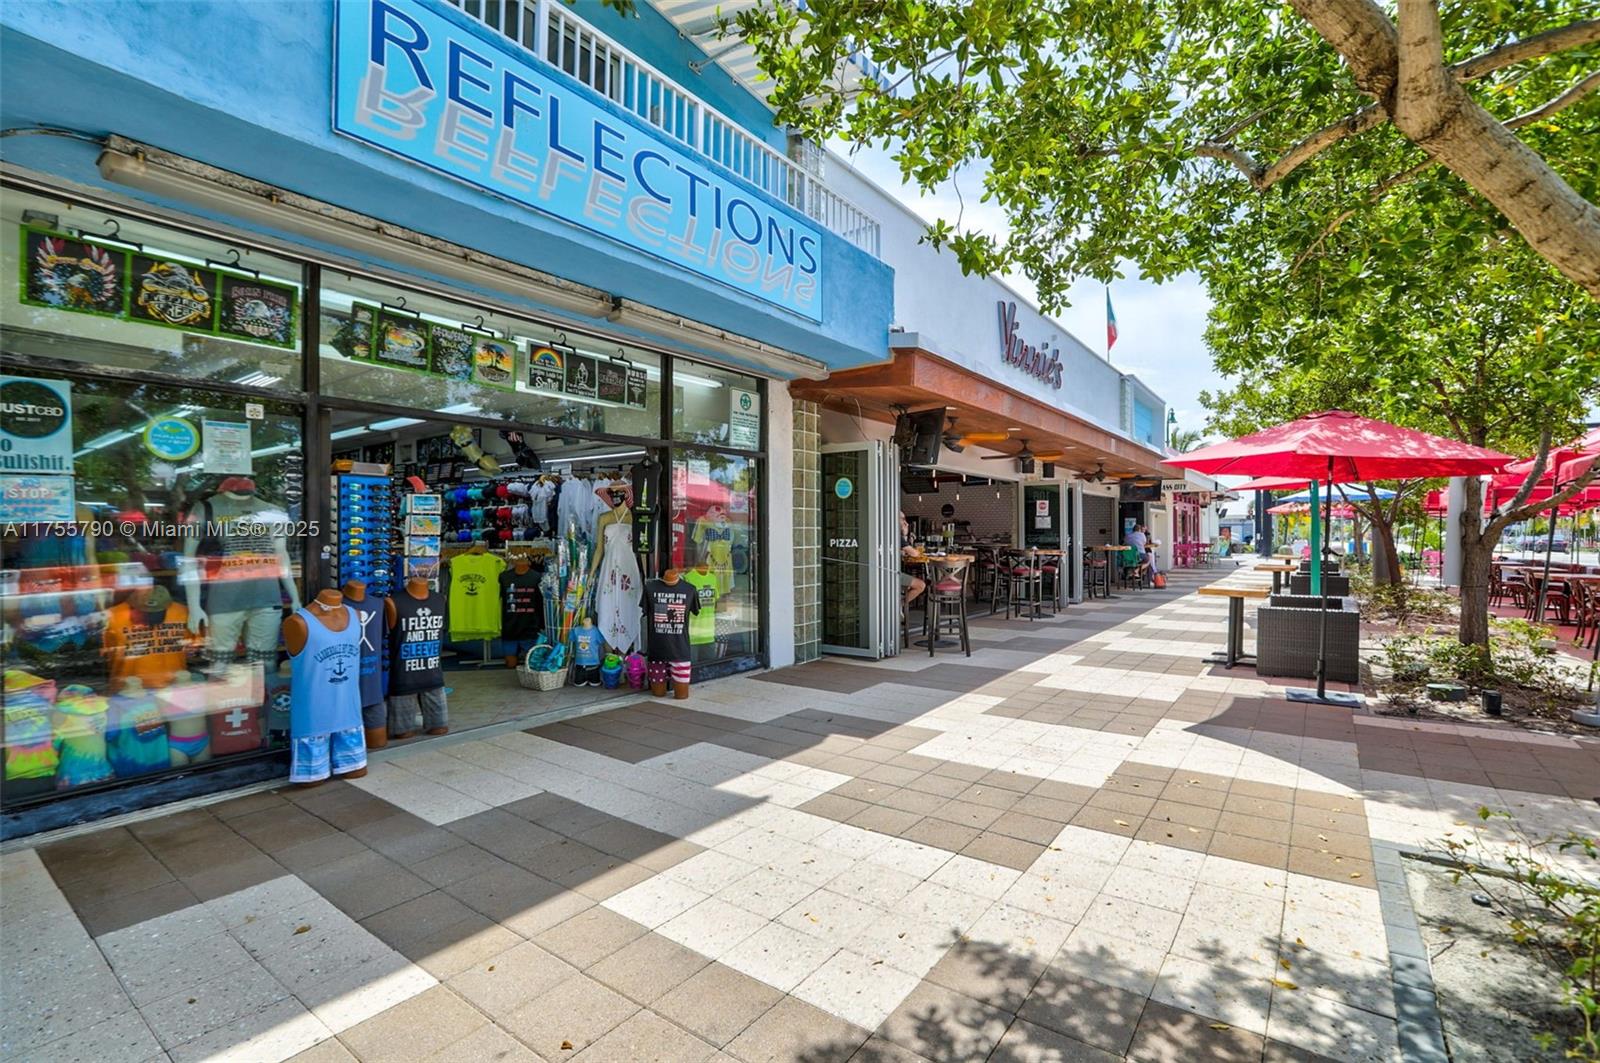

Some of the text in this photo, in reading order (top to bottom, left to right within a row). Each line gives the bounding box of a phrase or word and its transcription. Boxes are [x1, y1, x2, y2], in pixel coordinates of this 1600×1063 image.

[370, 0, 817, 275] REFLECTIONS
[997, 301, 1063, 390] Vinnie's
[0, 438, 12, 452] o
[8, 487, 50, 499] STOP
[829, 538, 859, 548] PIZZA
[402, 615, 443, 631] I FLEXED
[406, 629, 440, 643] AND THE
[401, 640, 441, 659] SLEEVE
[405, 658, 427, 672] FELL
